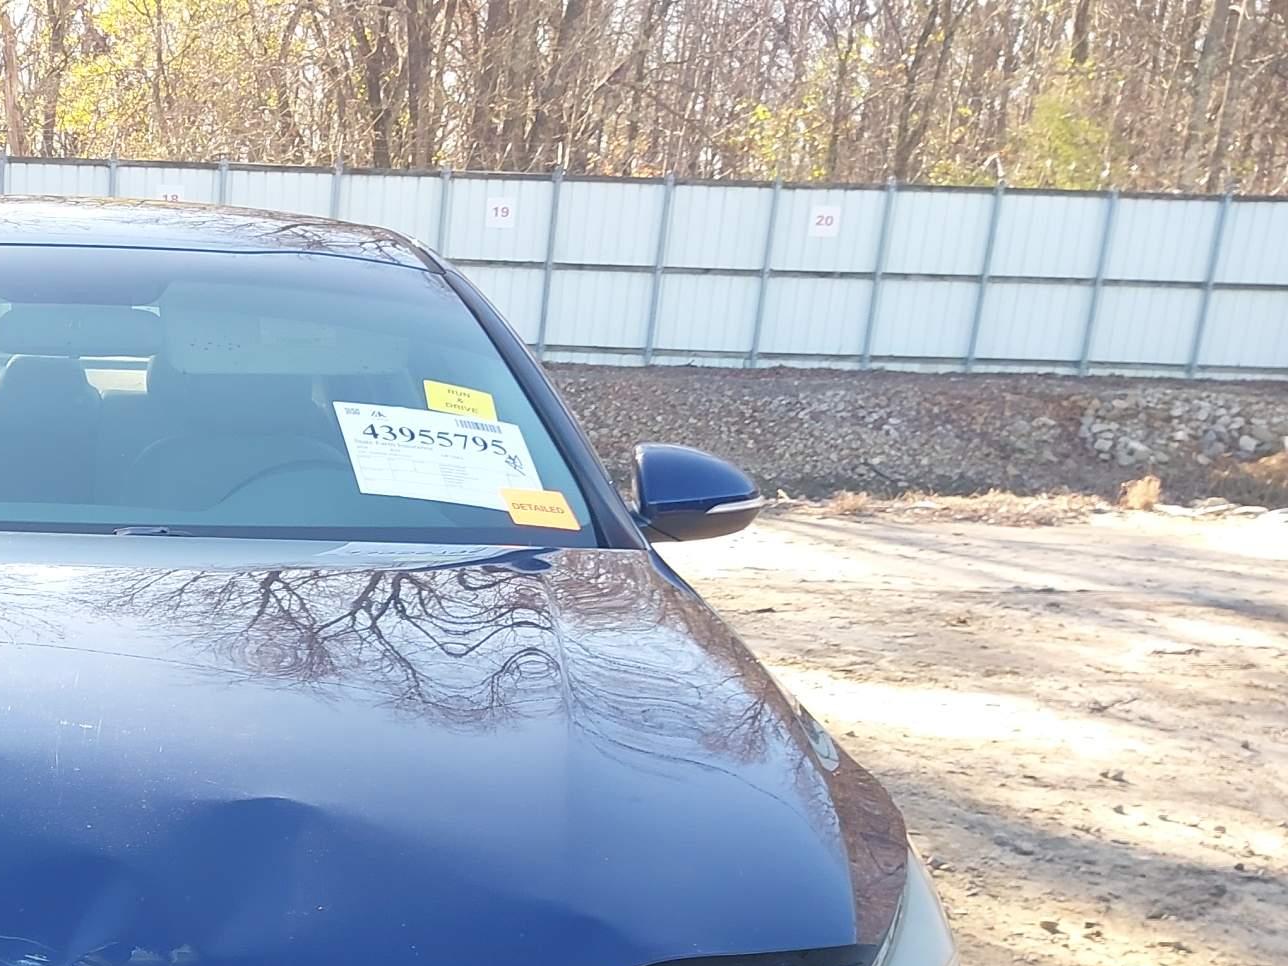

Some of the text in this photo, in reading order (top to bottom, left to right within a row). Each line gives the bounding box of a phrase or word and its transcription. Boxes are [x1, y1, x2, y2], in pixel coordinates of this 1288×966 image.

[162, 194, 179, 202] 18
[493, 207, 510, 218] 19
[815, 215, 834, 226] 20
[448, 389, 471, 398] RUN
[445, 402, 478, 413] DRIVE
[362, 424, 507, 456] 43955795
[511, 502, 565, 514] DETAILED
